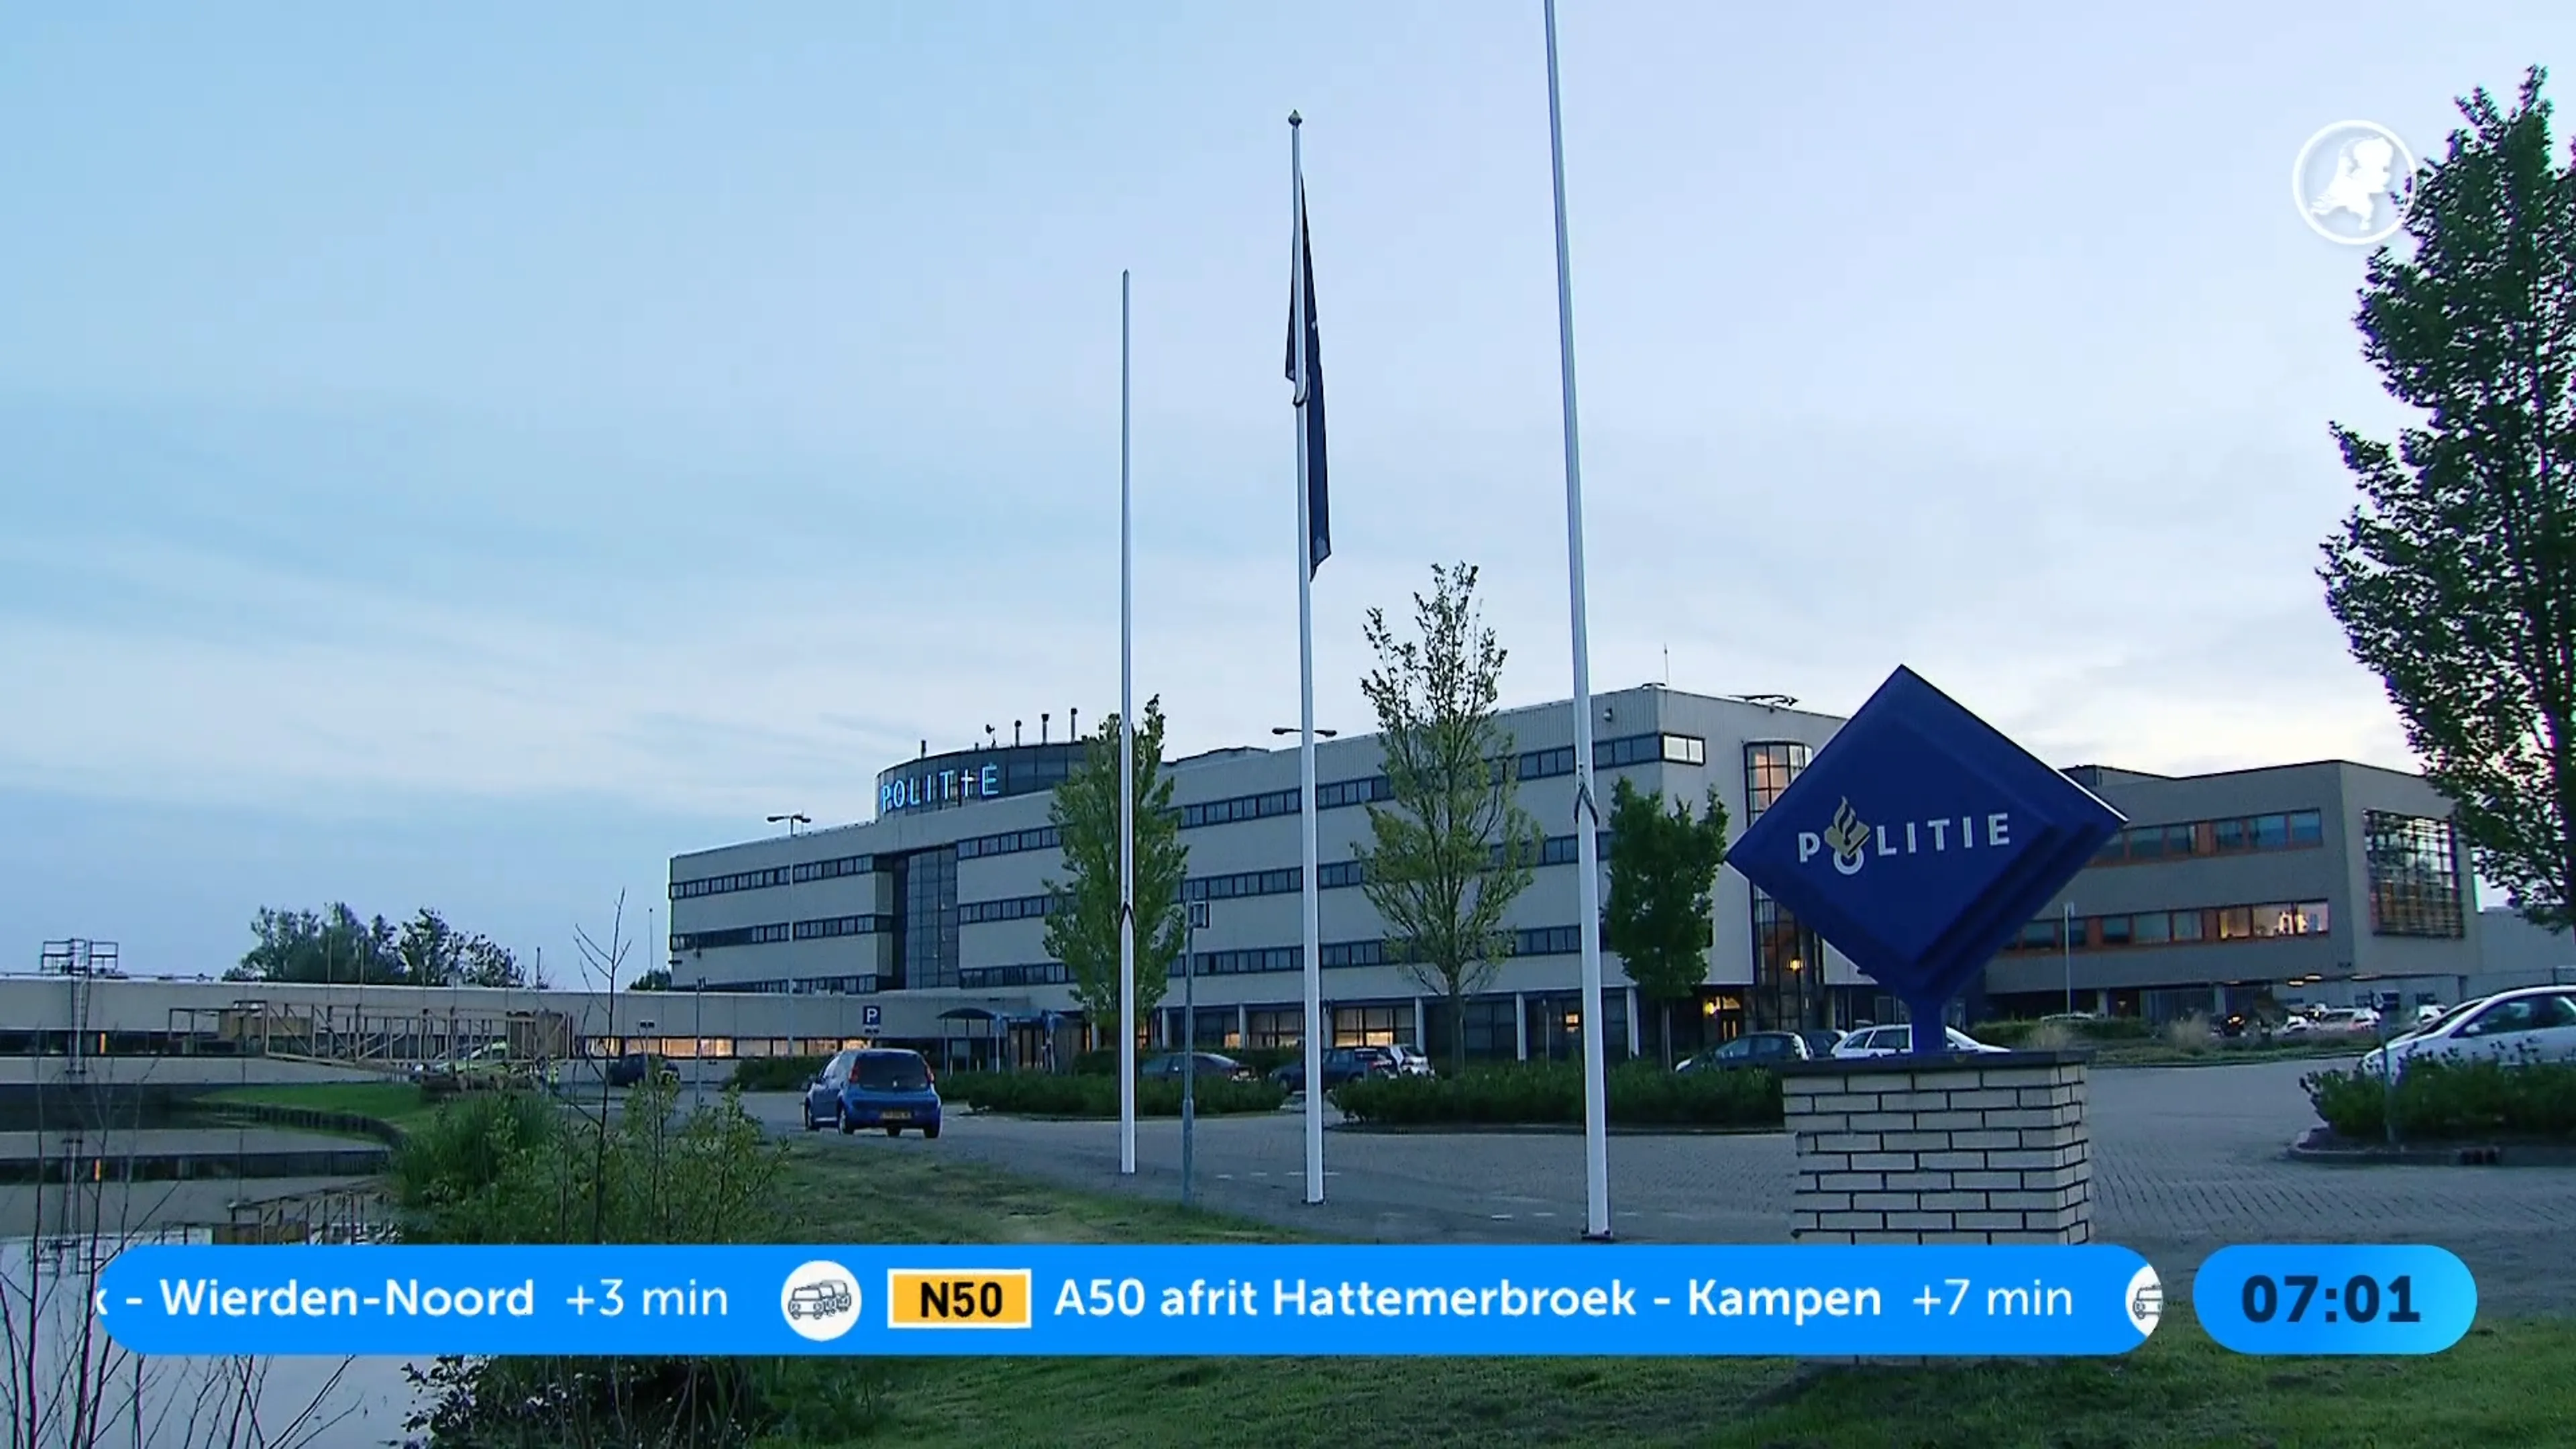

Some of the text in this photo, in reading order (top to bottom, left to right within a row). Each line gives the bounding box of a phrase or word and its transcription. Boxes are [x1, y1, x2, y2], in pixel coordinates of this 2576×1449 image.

[880, 763, 1000, 812] POLITIE
[1798, 812, 2010, 875] POLITIE
[866, 1008, 878, 1023] P
